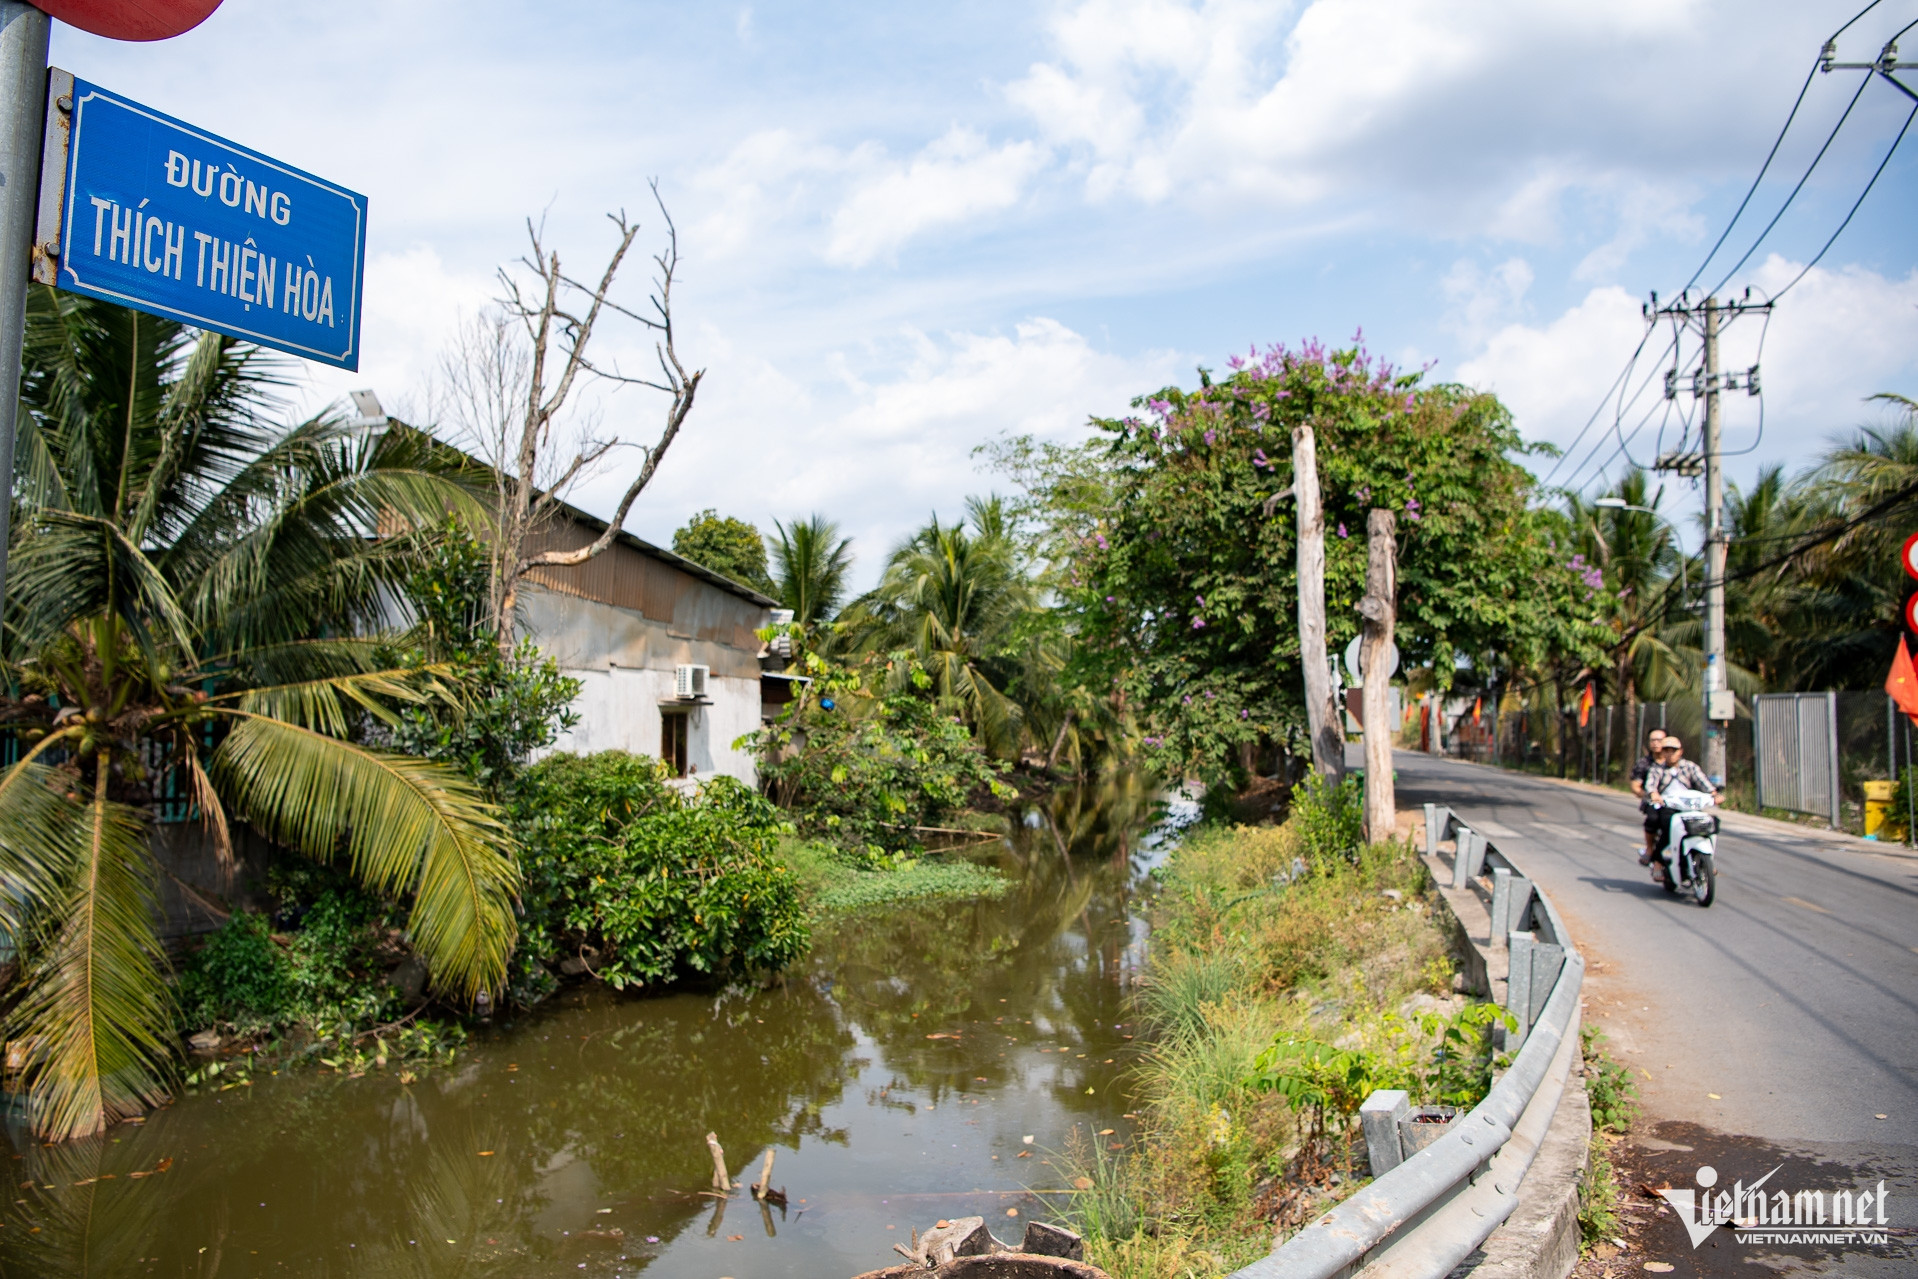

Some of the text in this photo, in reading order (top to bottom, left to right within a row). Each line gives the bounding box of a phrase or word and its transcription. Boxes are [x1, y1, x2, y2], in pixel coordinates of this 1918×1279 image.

[164, 149, 291, 226] ĐƯỜNG
[90, 196, 335, 328] THÍCH THIỆN HÒA
